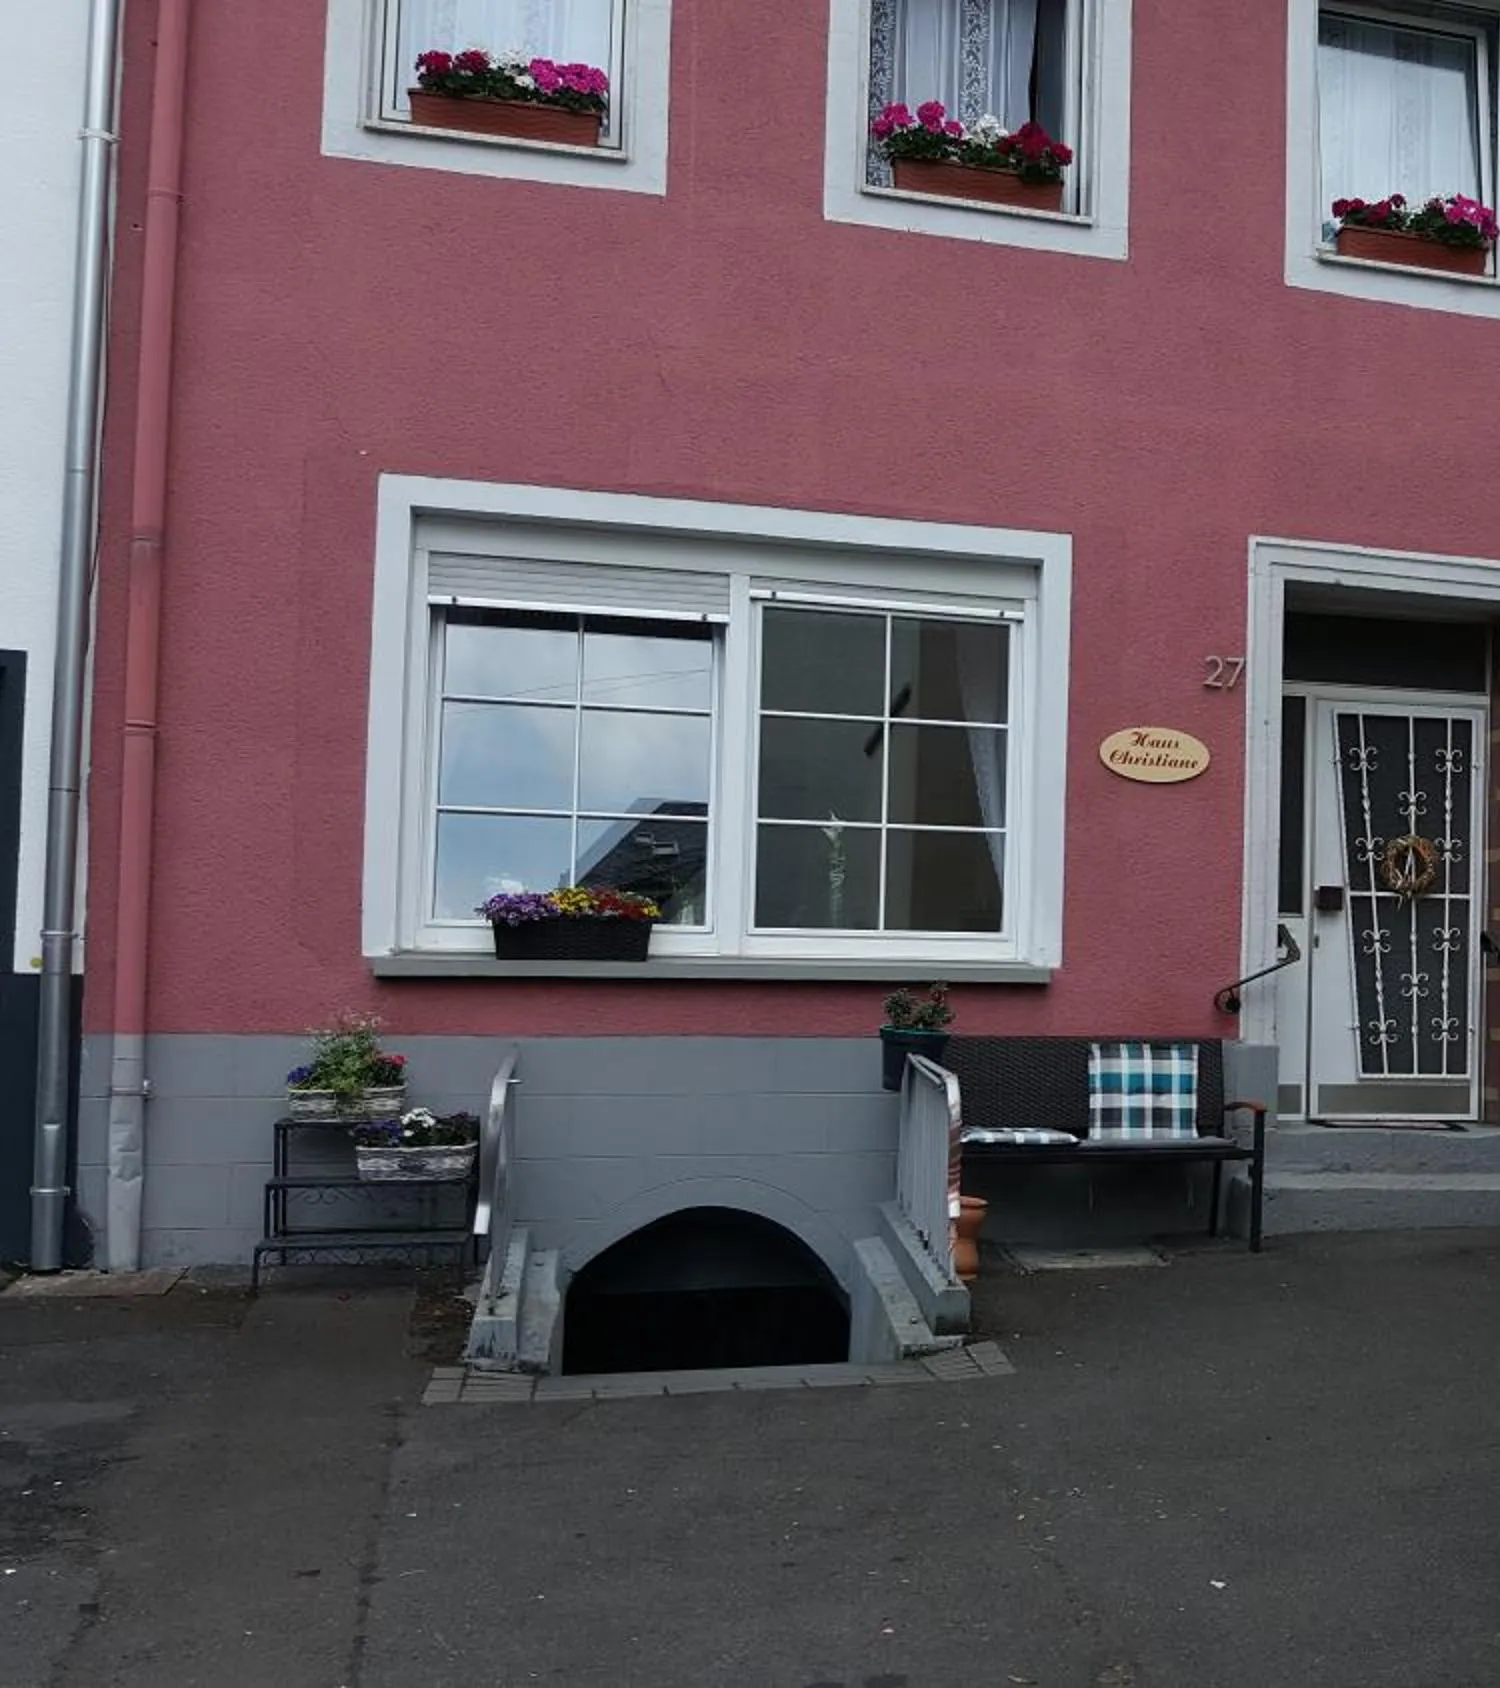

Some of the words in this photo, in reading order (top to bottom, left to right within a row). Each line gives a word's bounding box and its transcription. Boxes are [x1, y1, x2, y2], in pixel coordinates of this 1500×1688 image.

[1203, 655, 1244, 687] 27
[1131, 731, 1179, 749] Haus
[1109, 749, 1198, 769] Christiane
